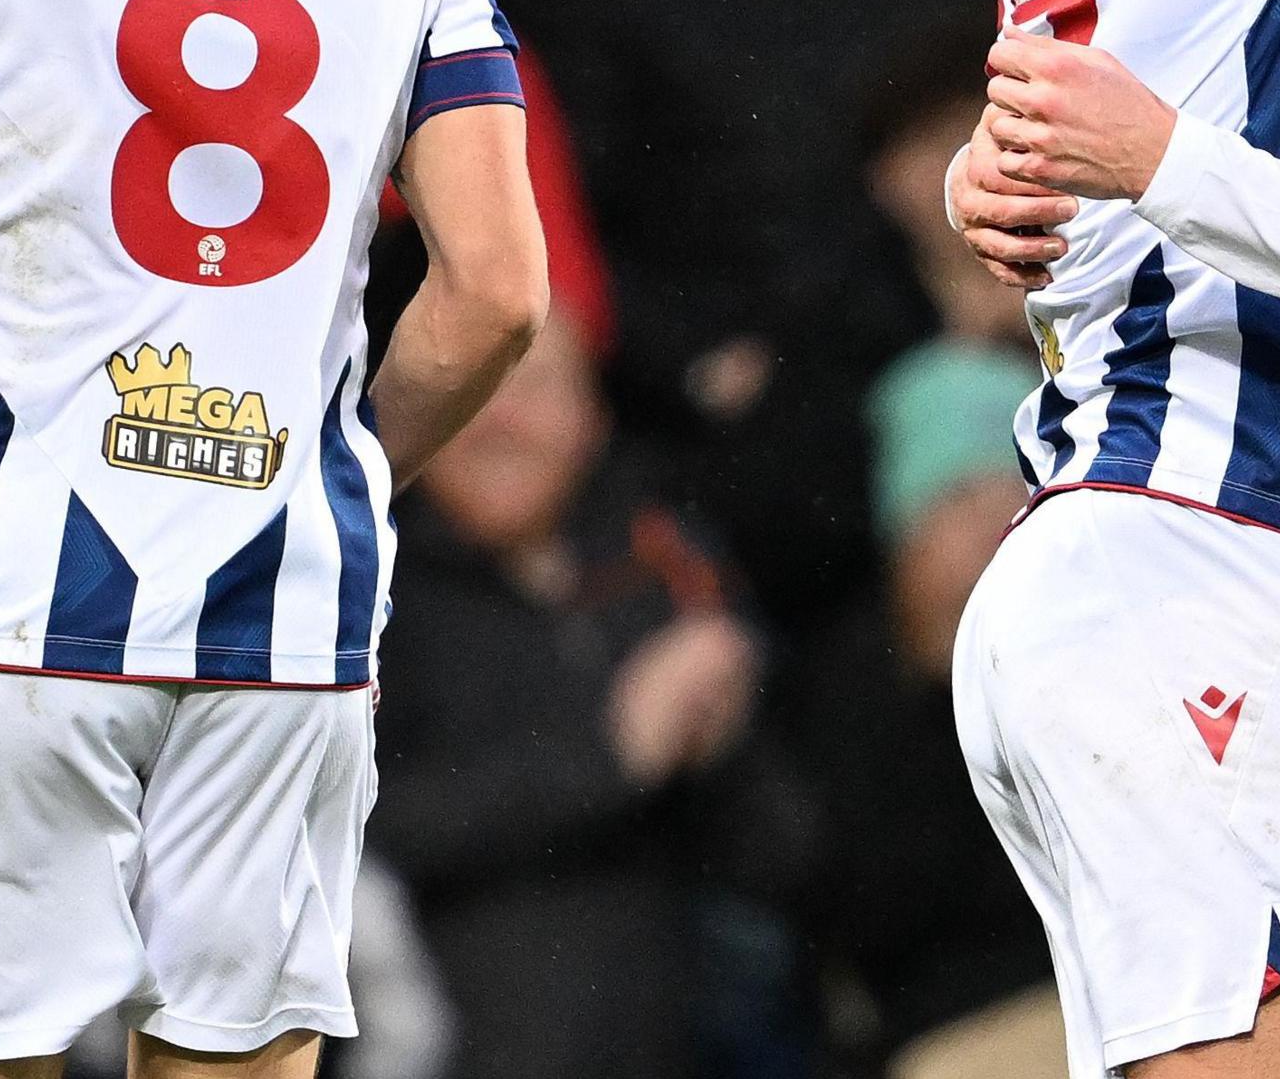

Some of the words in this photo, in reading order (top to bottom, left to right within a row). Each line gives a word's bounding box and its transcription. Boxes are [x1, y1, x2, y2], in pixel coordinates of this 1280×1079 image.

[199, 263, 223, 277] EFL
[121, 385, 270, 436] MEGA
[116, 427, 265, 479] RICHES
